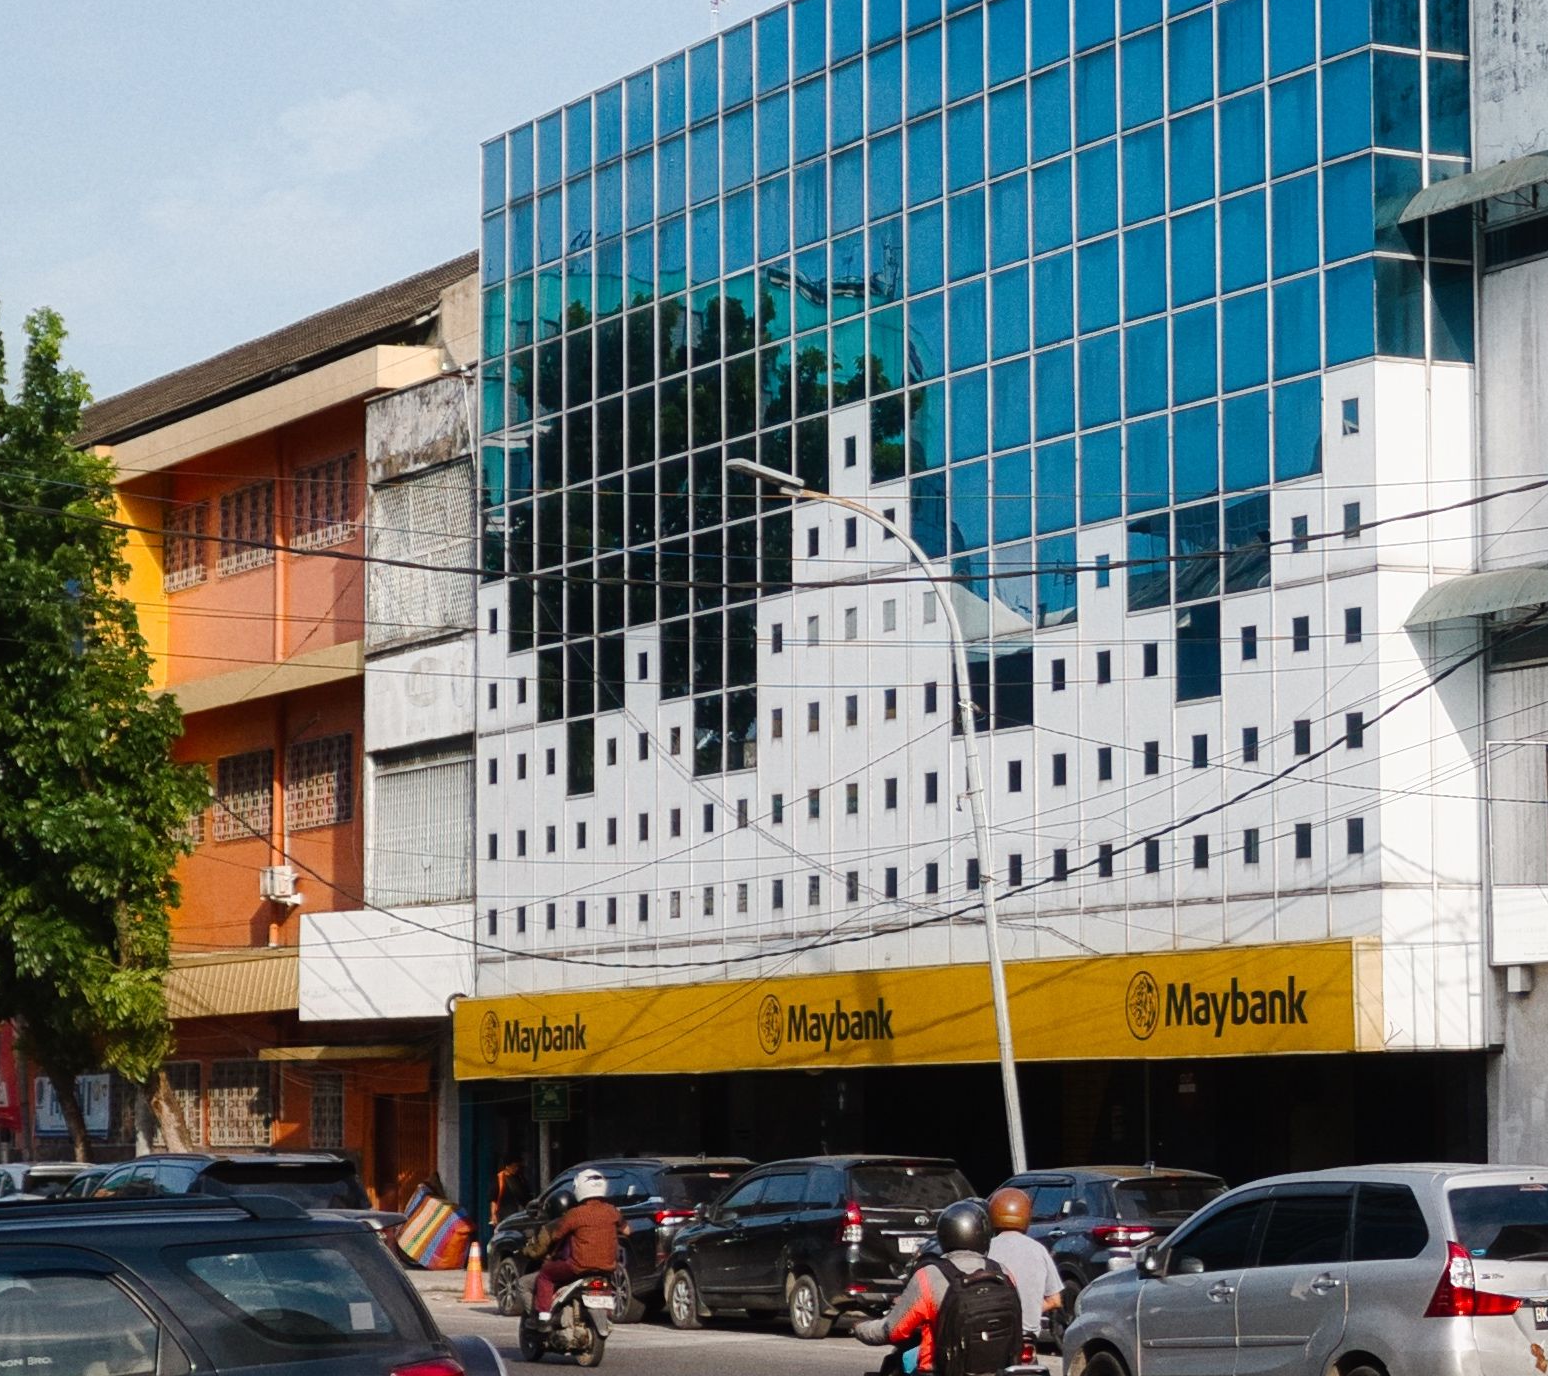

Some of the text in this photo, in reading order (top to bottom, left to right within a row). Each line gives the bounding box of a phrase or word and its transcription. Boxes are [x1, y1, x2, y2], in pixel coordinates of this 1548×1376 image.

[787, 997, 894, 1053] Maybank
[1165, 975, 1308, 1038] Maybank
[503, 1013, 586, 1062] Maybank
[1535, 1306, 1548, 1323] BK
